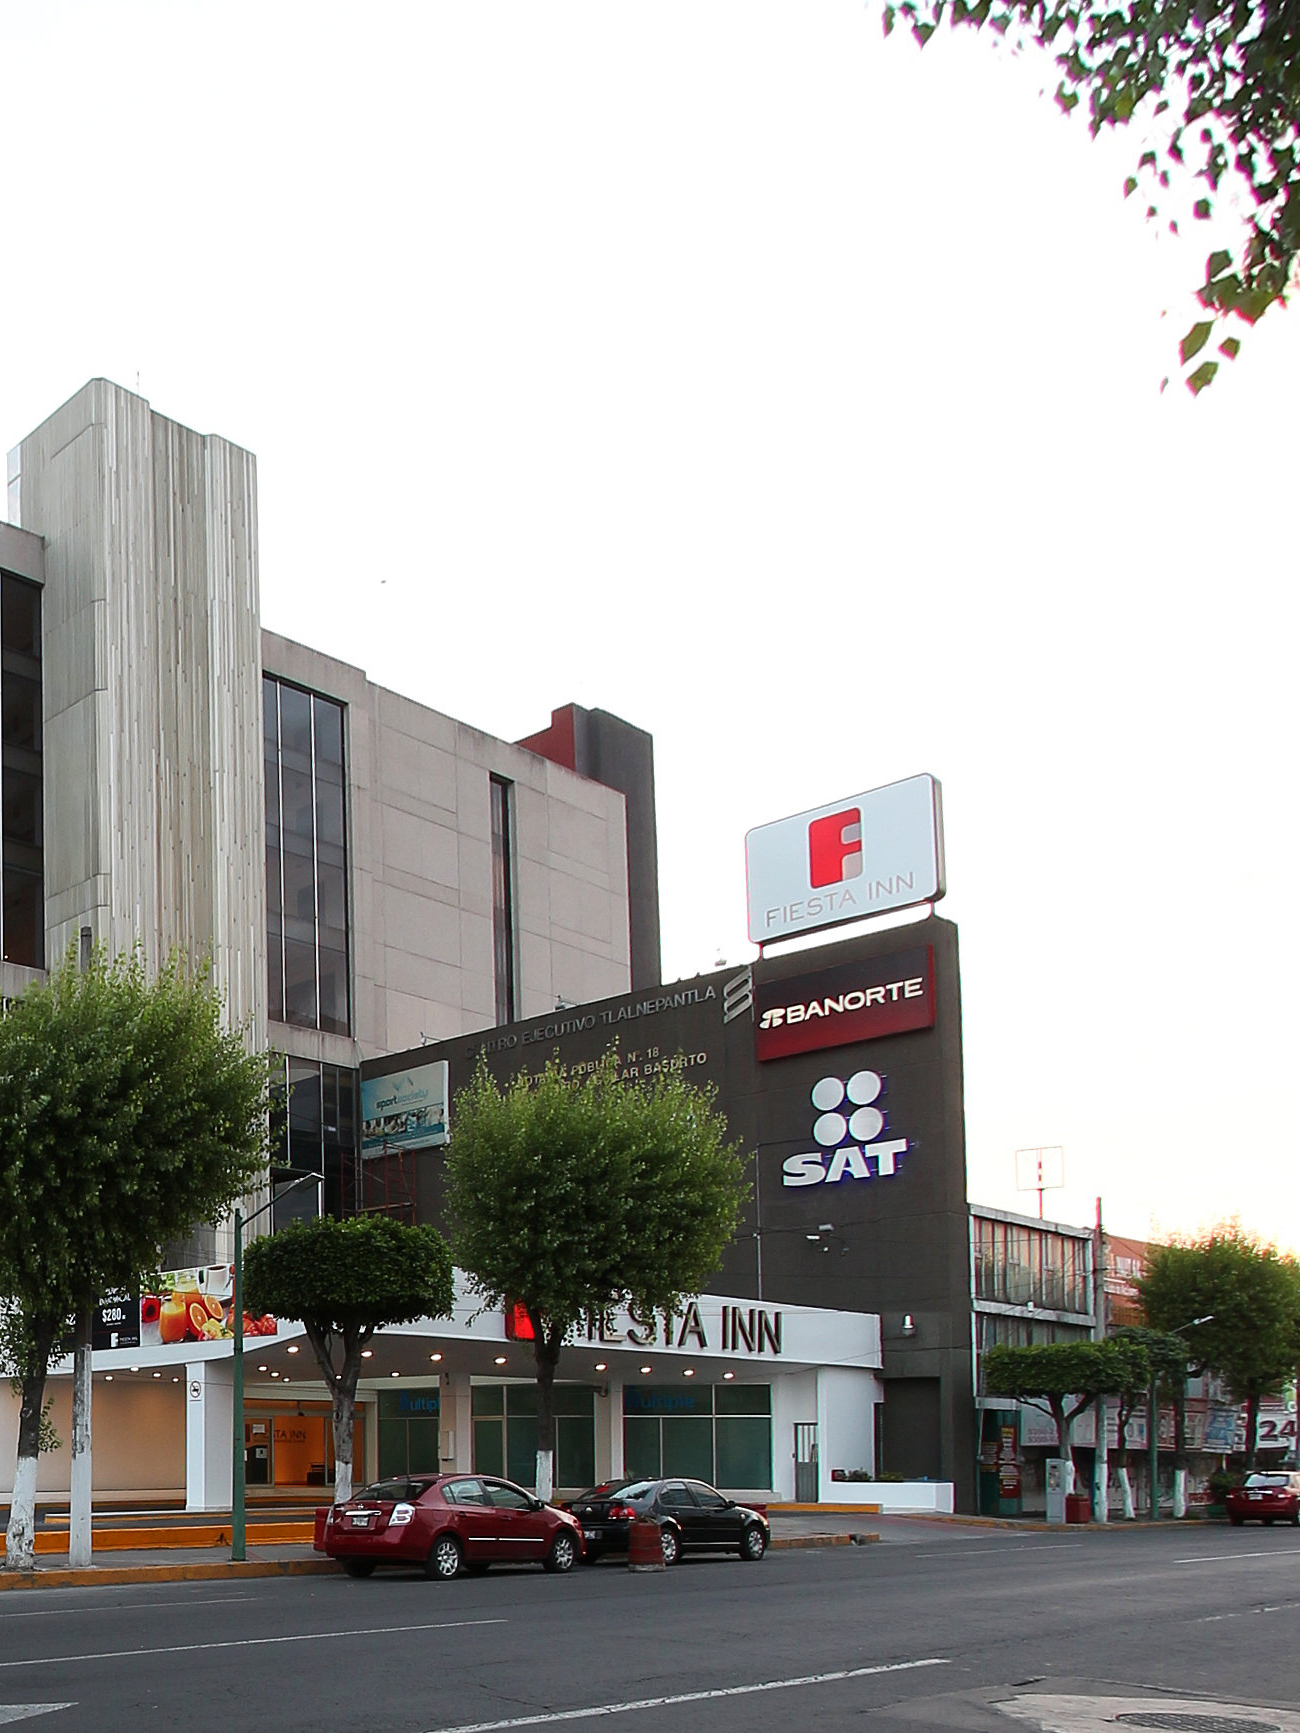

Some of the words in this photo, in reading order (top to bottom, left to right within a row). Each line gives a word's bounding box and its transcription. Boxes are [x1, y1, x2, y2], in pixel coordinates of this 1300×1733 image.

[766, 889, 857, 928] FIESTA
[868, 871, 914, 900] INN
[521, 1014, 596, 1046] EJECUTIVO
[599, 985, 717, 1025] TLALNEPANTLA
[786, 977, 924, 1024] BANORTE
[644, 1052, 708, 1076] BASURTO
[647, 1046, 660, 1059] 18
[783, 1138, 908, 1187] SAT
[102, 1308, 121, 1322] $280
[587, 1301, 709, 1349] IESTA
[721, 1305, 783, 1354] INN
